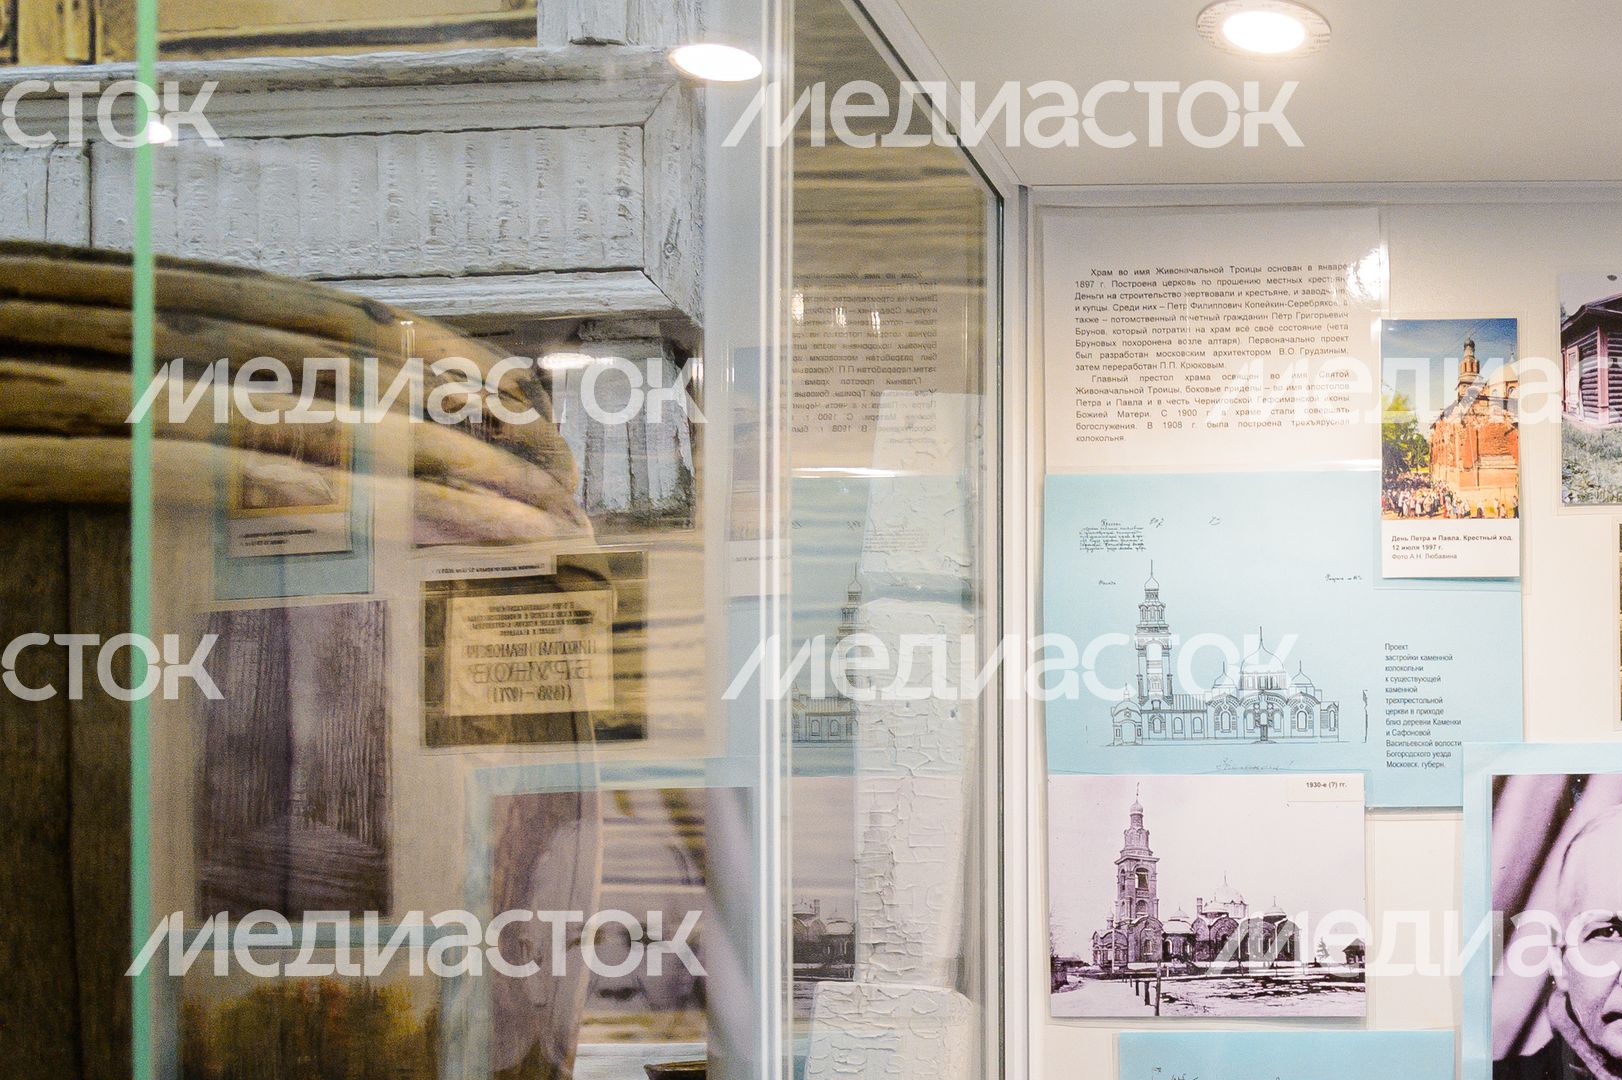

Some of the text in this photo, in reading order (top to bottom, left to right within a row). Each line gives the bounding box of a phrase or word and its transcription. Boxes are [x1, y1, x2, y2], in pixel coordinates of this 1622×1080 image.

[1090, 268, 1113, 277] Храм
[1155, 265, 1224, 274] Живоначальной
[1229, 264, 1262, 274] Троицы
[1384, 642, 1408, 651] Проект
[1385, 653, 1418, 662] застройки
[1389, 674, 1441, 684] существующей
[1384, 685, 1418, 693] каменной
[1385, 708, 1409, 716] церкви
[1431, 718, 1462, 726] Каменки
[1391, 728, 1431, 737] Сафоновой
[1385, 749, 1451, 759] Богородского уезда
